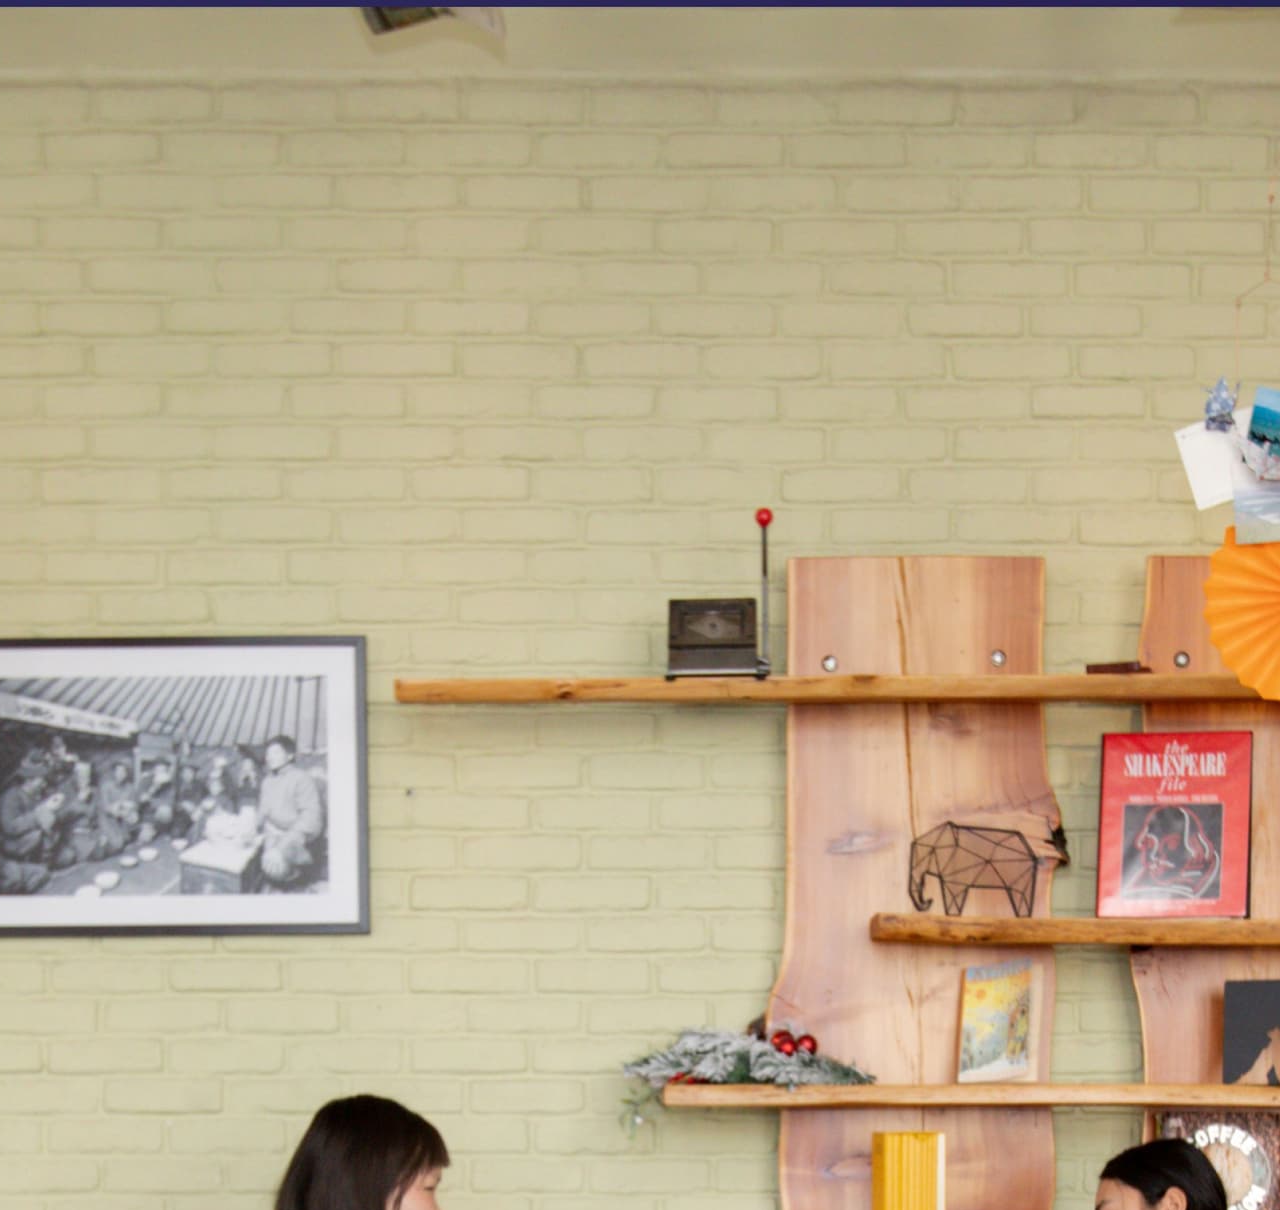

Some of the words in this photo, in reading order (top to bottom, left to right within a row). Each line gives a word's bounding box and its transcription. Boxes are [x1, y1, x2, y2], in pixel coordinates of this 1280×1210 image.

[1164, 739, 1190, 754] the
[1123, 752, 1227, 777] SHAKESPEARE
[1157, 777, 1188, 794] file
[1186, 1123, 1258, 1156] OFFEE
